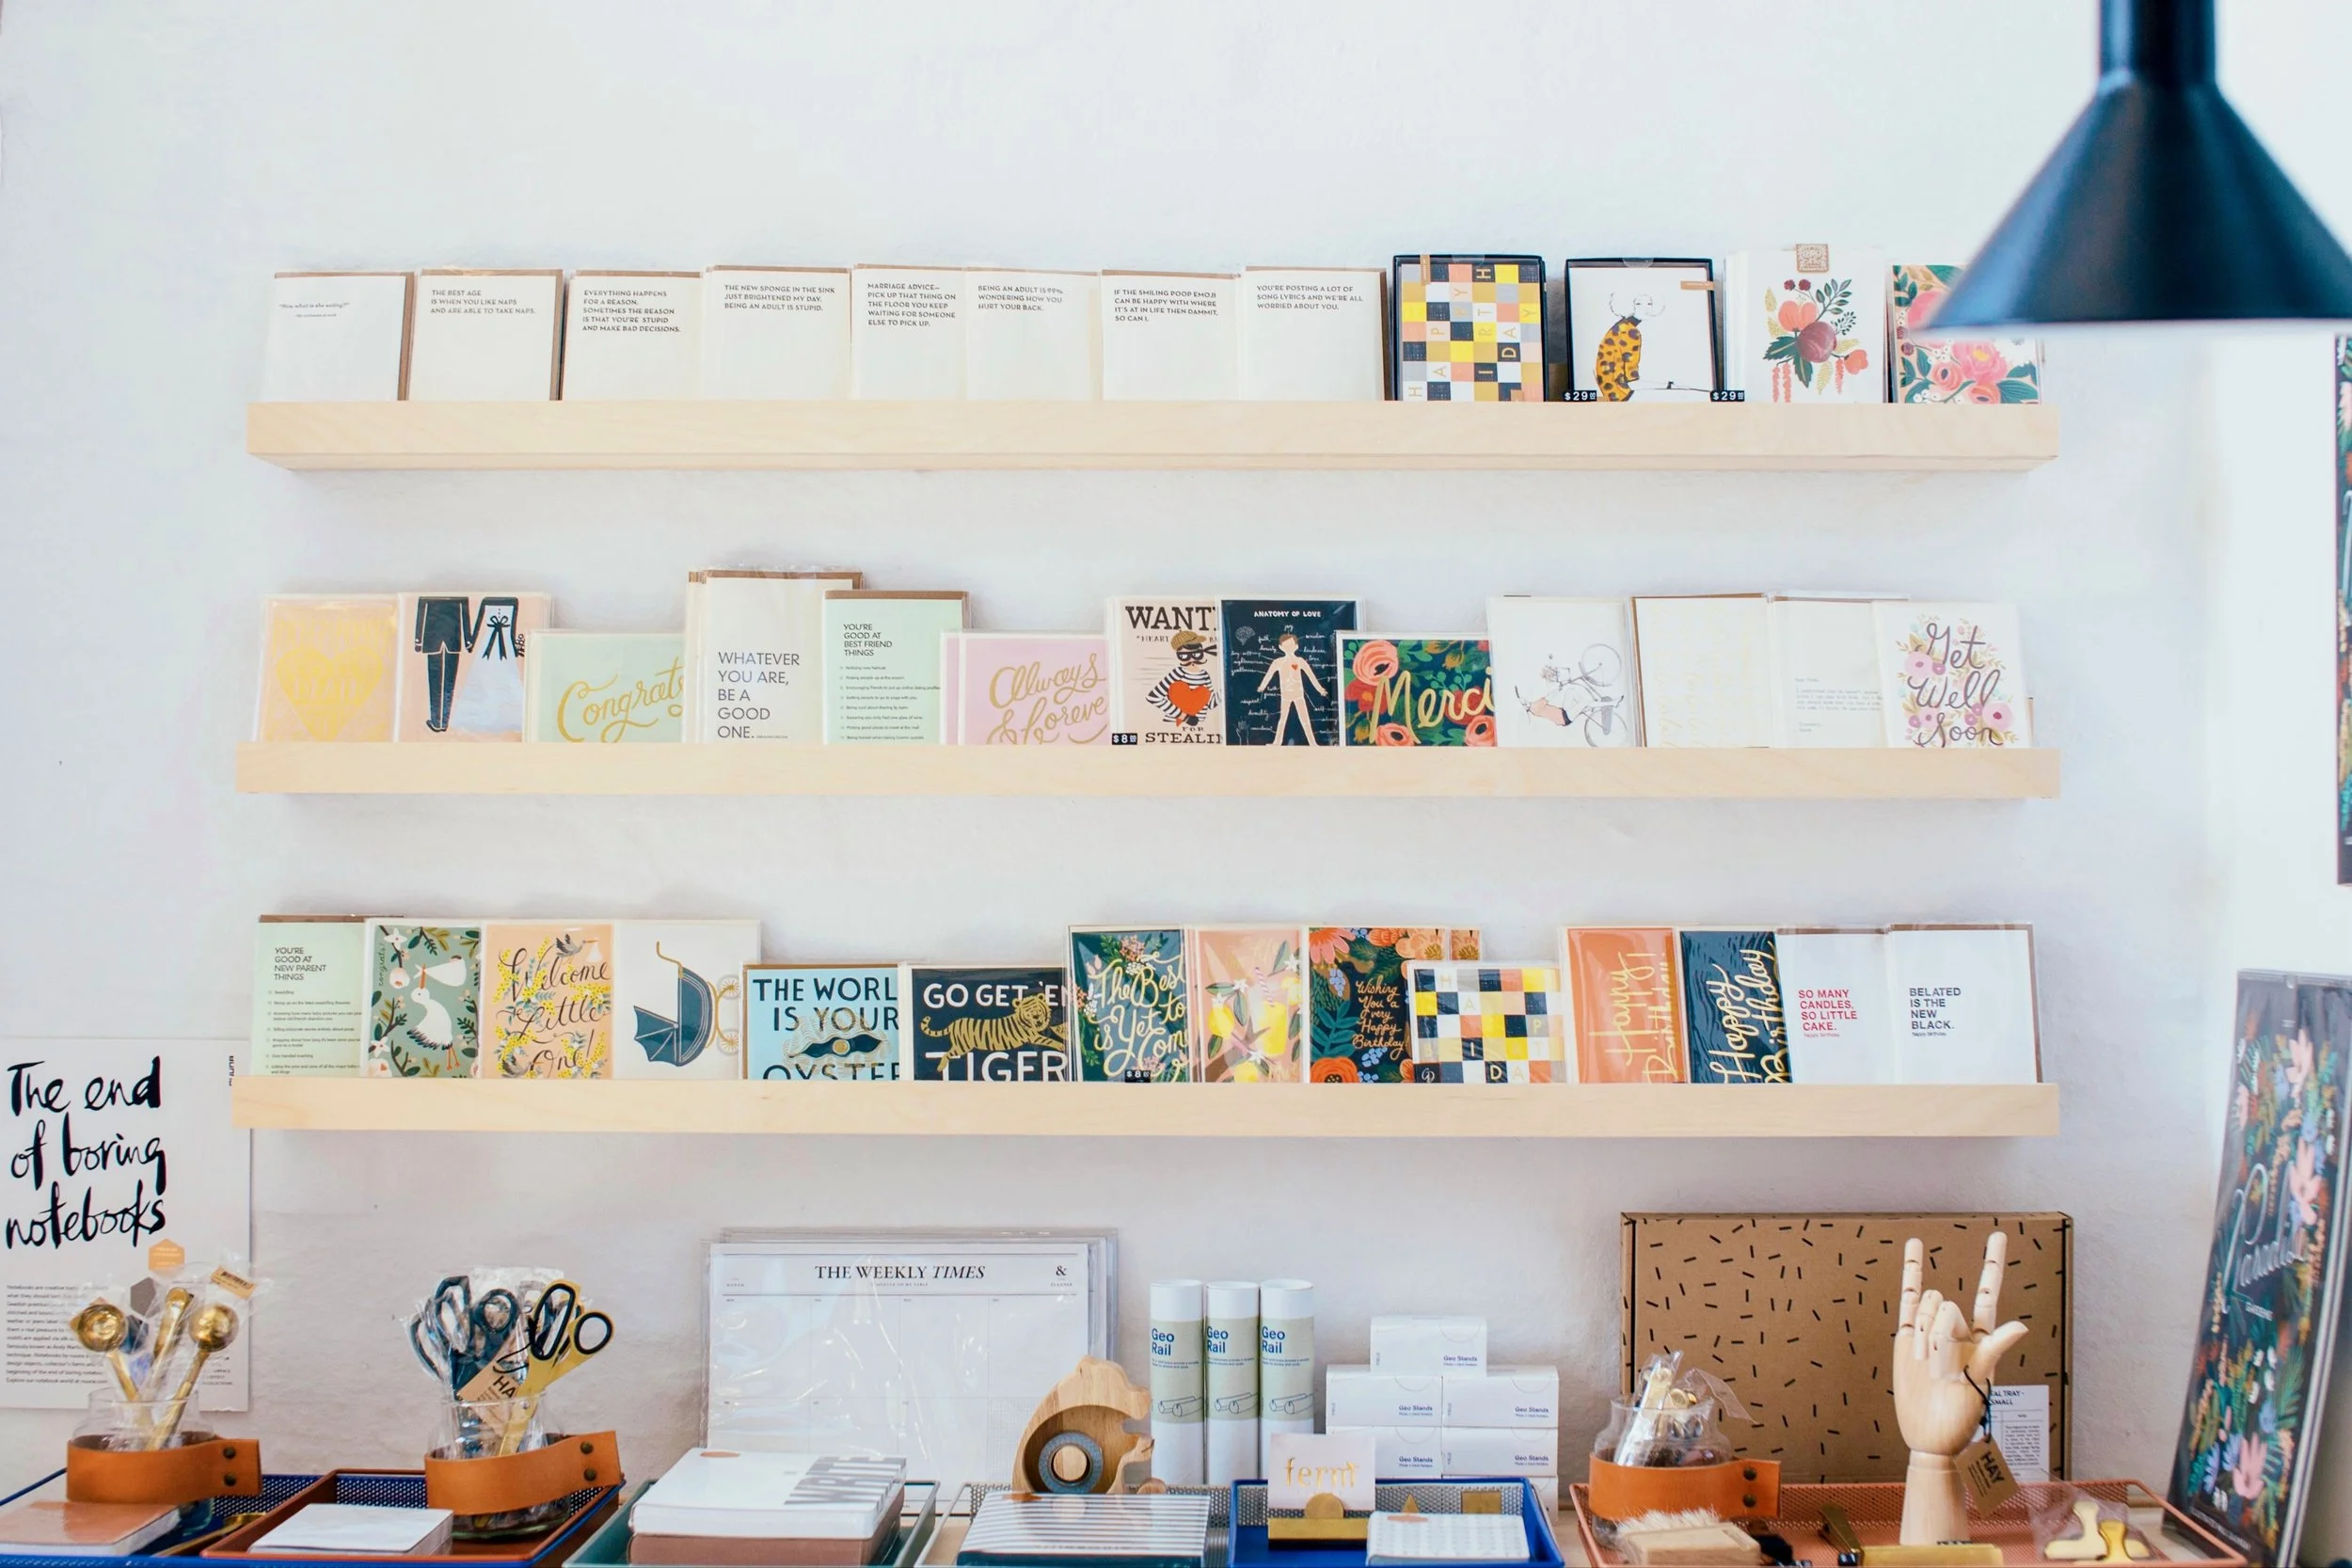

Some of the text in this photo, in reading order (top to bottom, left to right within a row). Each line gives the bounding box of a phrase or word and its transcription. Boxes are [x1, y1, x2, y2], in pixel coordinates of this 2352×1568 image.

[1125, 606, 1216, 631] WANT
[1914, 623, 1986, 670] Get
[718, 652, 800, 666] WHATEVER
[718, 671, 789, 686] YOU ARE,
[718, 689, 750, 702] BE A
[1907, 669, 2000, 709] Well
[1369, 666, 1494, 745] Merci
[718, 707, 770, 721] GOOD
[718, 726, 755, 739] ONE.
[1912, 713, 2004, 748] Soon
[275, 947, 305, 956] YOU'RE
[274, 964, 326, 973] NEW PARENT
[499, 947, 611, 1003] Welcome
[274, 973, 304, 981] THINGS
[1088, 959, 1132, 1008] The
[753, 977, 804, 1001] THE
[1356, 974, 1400, 1002] Wishing
[1798, 989, 1850, 999] SO MANY
[1910, 987, 1962, 997] BELATED
[923, 984, 968, 1008] GO
[976, 985, 1028, 1007] GET
[1910, 999, 1946, 1007] IS THE
[1359, 995, 1384, 1019] You
[1588, 951, 1659, 1066] Happy
[1911, 1009, 1937, 1019] NEW
[496, 994, 610, 1044] Little
[773, 1006, 899, 1032] IS YOUR
[1706, 963, 1762, 1083] Happy
[1802, 1010, 1858, 1021] SO LITTLE
[1356, 1019, 1402, 1035] Happy
[1803, 1022, 1837, 1031] CAKE.
[1912, 1021, 1955, 1030] BLACK.
[925, 1051, 1068, 1082] TIGER
[7, 1055, 161, 1117] The end
[11, 1112, 167, 1196] of boring
[6, 1179, 167, 1249] notebooks
[815, 1265, 986, 1279] THE WEEKLY TIMES
[1056, 1265, 1067, 1277] &
[1152, 1328, 1175, 1343] Geo
[1207, 1325, 1229, 1340] Geo
[1262, 1325, 1285, 1340] Geo
[1152, 1342, 1171, 1356] Rail
[1207, 1340, 1226, 1354] Rail
[1262, 1340, 1282, 1354] Rail
[1980, 1450, 2004, 1483] HAY
